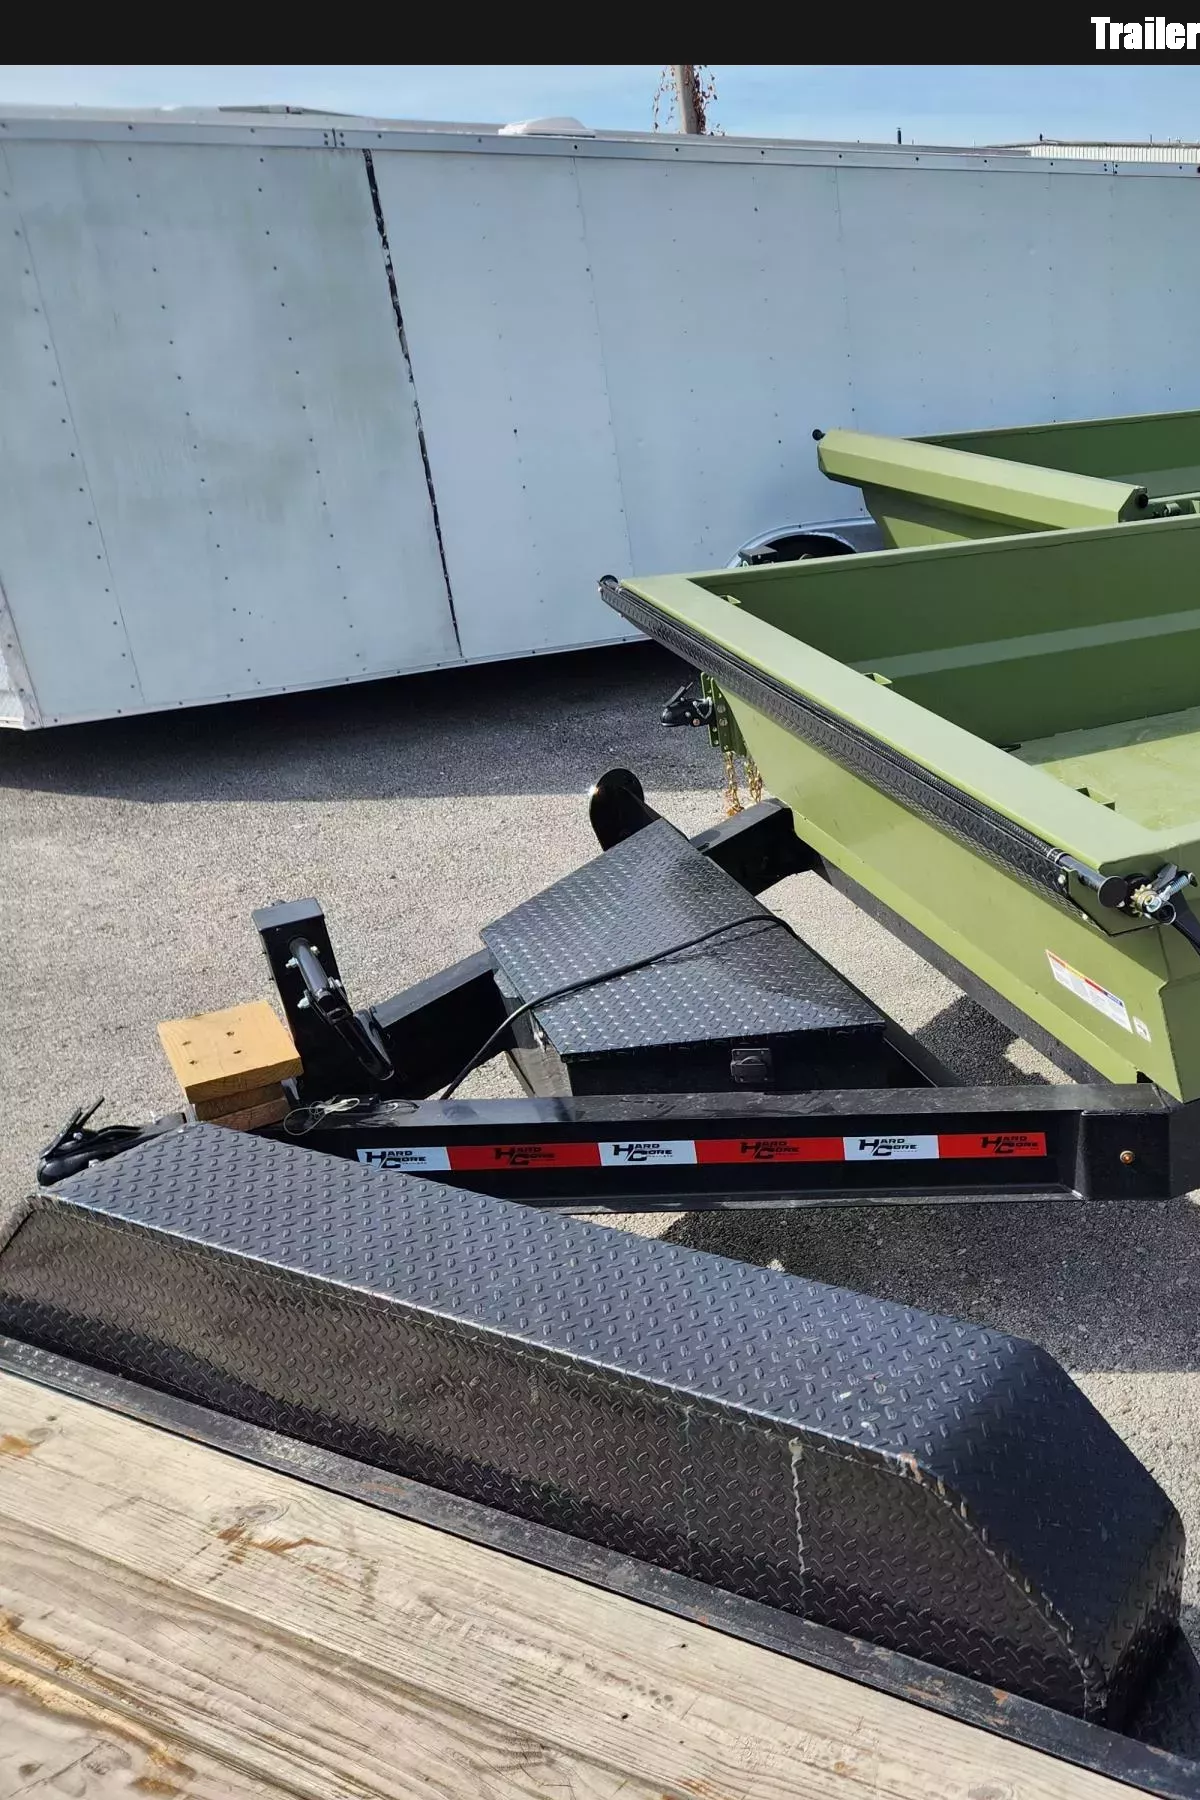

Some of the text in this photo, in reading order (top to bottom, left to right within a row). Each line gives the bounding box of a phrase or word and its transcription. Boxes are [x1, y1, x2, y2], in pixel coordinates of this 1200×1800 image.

[612, 1144, 660, 1158] HARD
[858, 1139, 905, 1152] HARD
[872, 1145, 917, 1156] CORE
[365, 1150, 412, 1165] HARD
[626, 1150, 672, 1161] CORE
